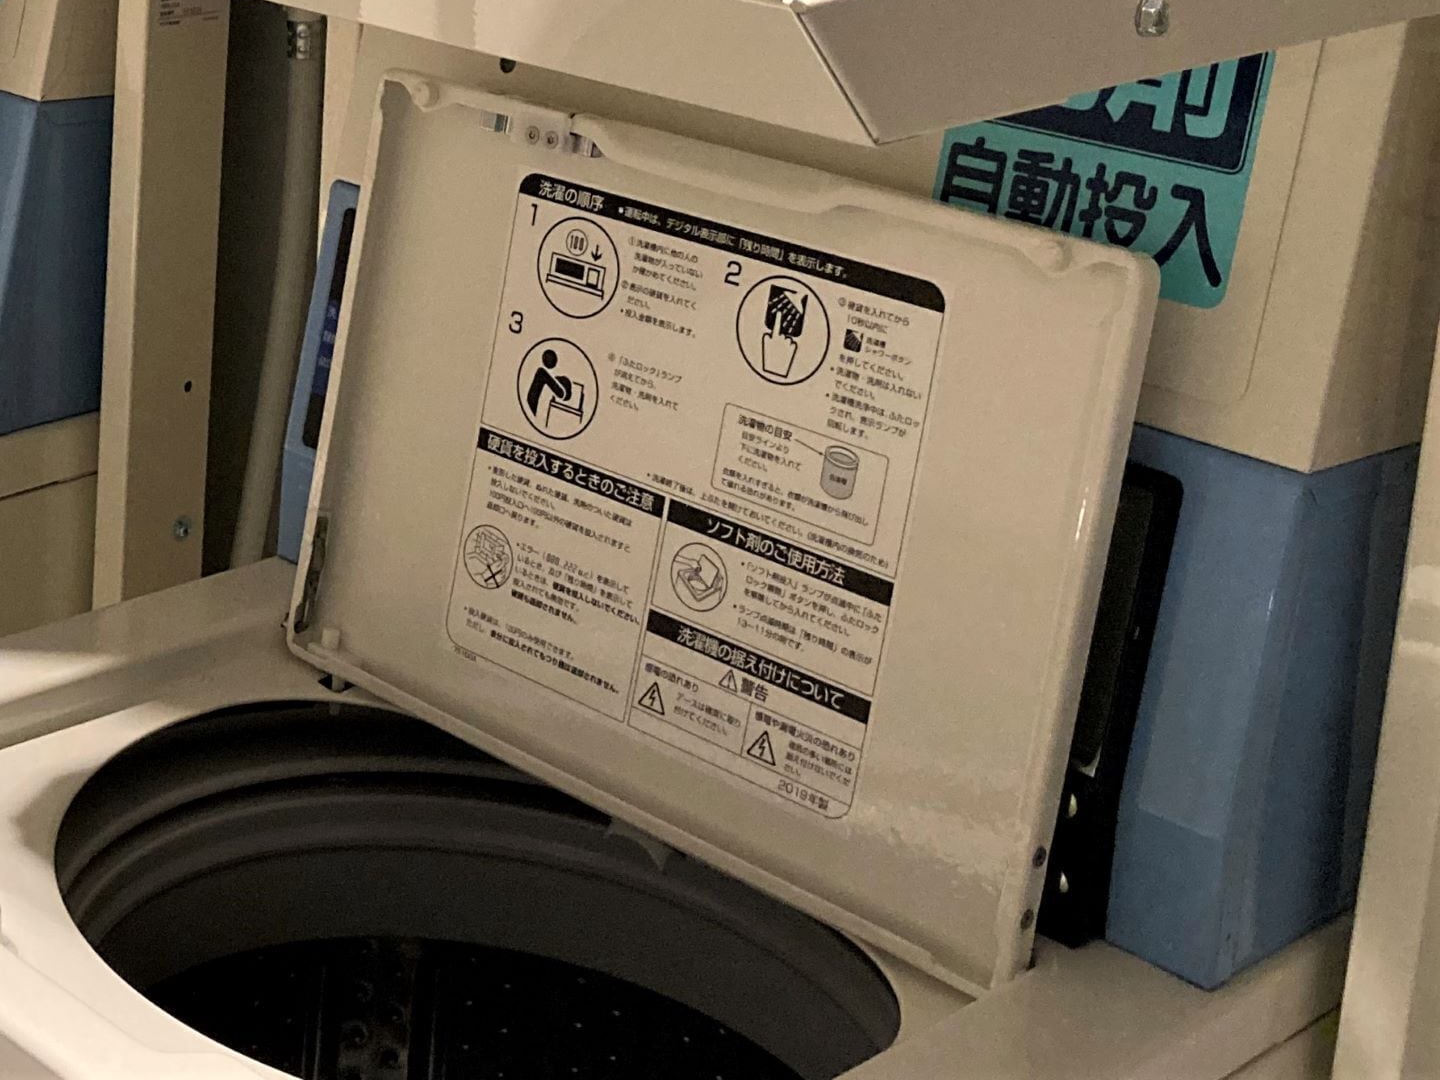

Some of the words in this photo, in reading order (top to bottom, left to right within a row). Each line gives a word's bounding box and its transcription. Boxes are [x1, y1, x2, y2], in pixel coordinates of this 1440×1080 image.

[538, 179, 606, 212] 洗濯の順序
[530, 203, 538, 227] 1
[940, 136, 1222, 287] 自動投入
[723, 259, 743, 287] 2
[509, 310, 524, 335] 3
[737, 413, 793, 442] 洗濯物の目安
[486, 433, 655, 512] 硬貨を投入するときのご注意
[706, 517, 846, 586] ソフト剤のご使用方法
[676, 624, 846, 710] 洗濯機の据え付けについて
[740, 676, 769, 703] 警告
